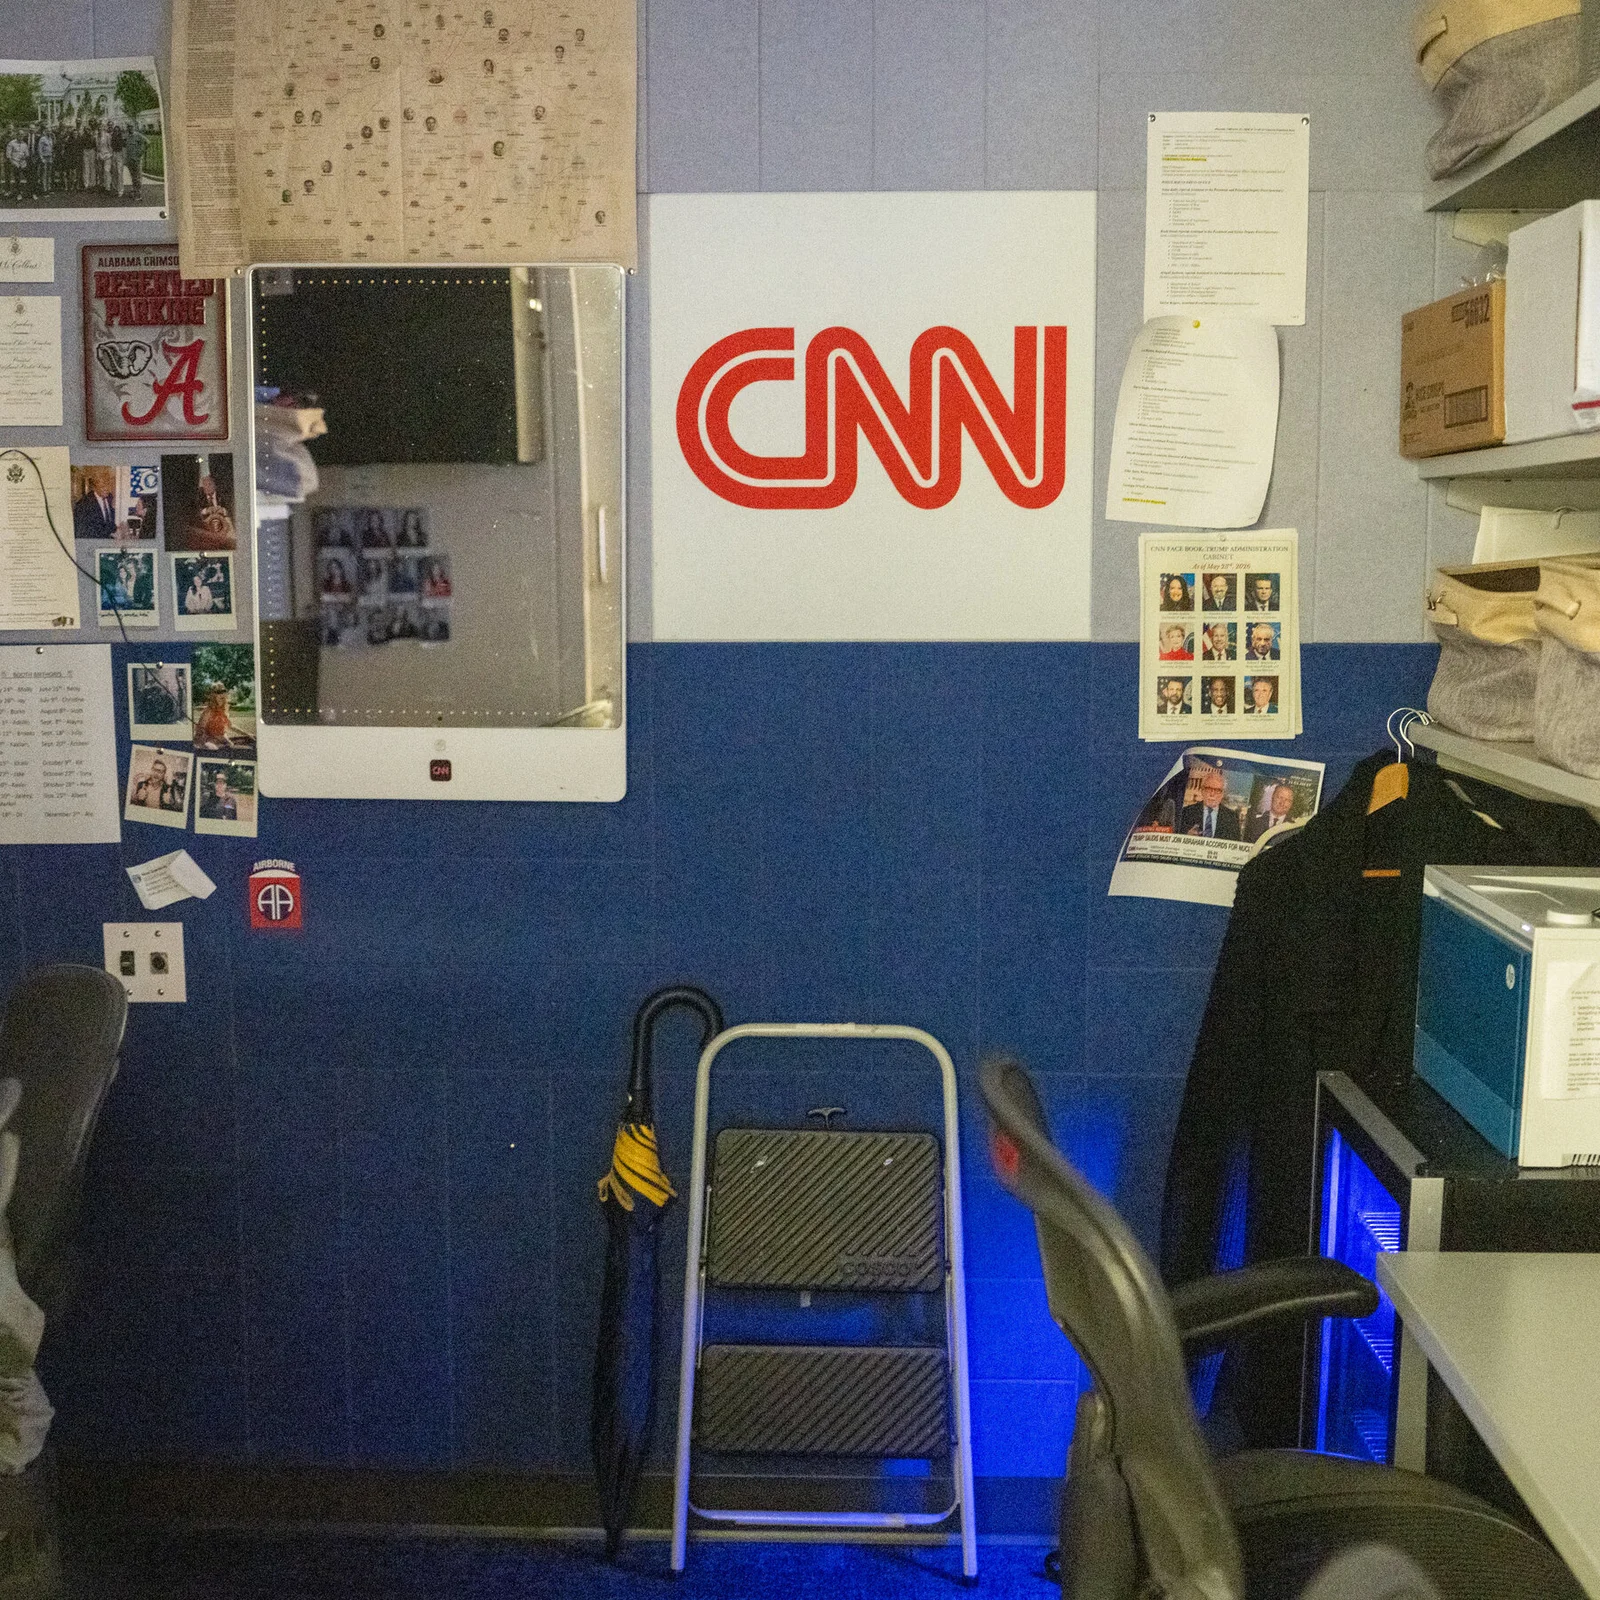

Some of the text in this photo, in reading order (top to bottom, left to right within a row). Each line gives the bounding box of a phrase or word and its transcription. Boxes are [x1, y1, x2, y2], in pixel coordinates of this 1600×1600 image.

[98, 255, 179, 267] ALABAMA CRIMSO
[94, 271, 215, 298] RESERVED
[104, 297, 205, 327] PARKING
[121, 338, 209, 426] A
[676, 325, 1068, 510] CNN
[1203, 553, 1234, 561] CABINET
[431, 765, 450, 776] CNN
[1159, 834, 1171, 843] MUST
[1171, 836, 1182, 844] JOIN
[1182, 837, 1205, 847] ABRAHAM
[1205, 839, 1228, 850] ACCORDS
[1228, 843, 1238, 851] FOR
[253, 859, 295, 872] AIRBORNE
